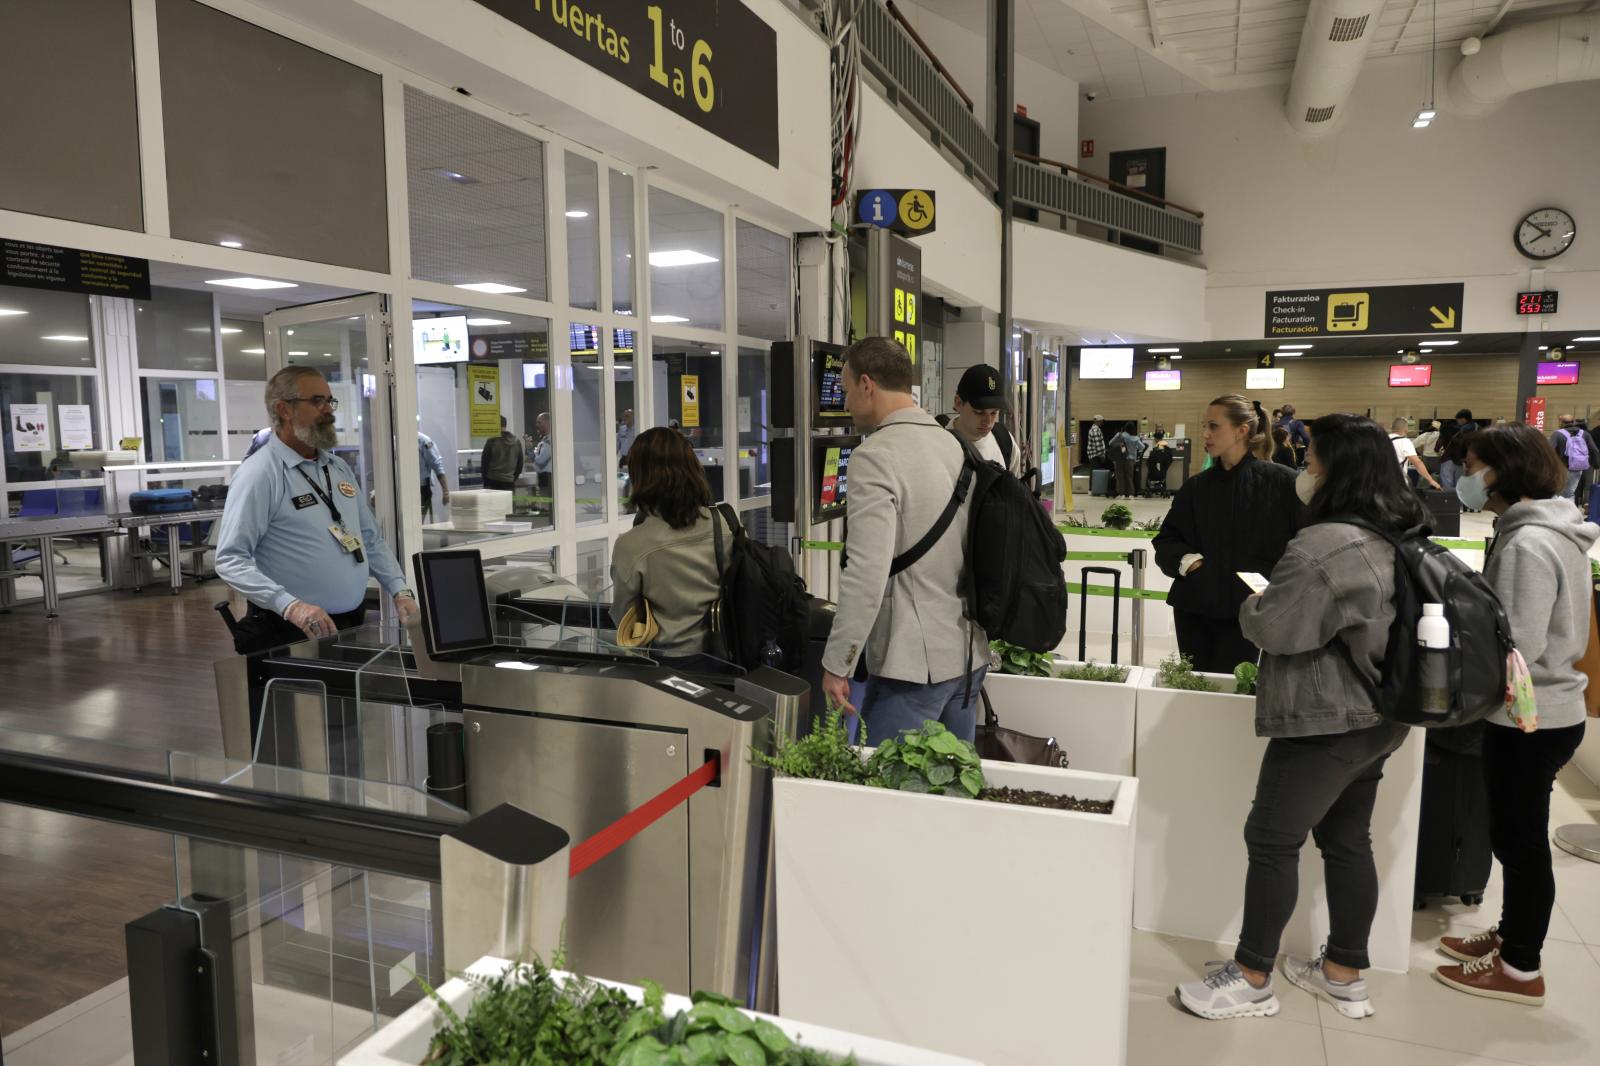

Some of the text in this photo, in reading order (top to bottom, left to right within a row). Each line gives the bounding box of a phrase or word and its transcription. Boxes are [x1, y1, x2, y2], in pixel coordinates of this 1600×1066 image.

[670, 18, 685, 50] to
[534, 0, 714, 112] uertas 1 a 6
[1273, 294, 1320, 303] Fakturazioa
[1272, 305, 1306, 314] Check-in
[1272, 315, 1315, 324] Facturation
[1272, 325, 1319, 334] Facturación
[1407, 351, 1416, 363] 5
[1551, 347, 1562, 360] 6
[1261, 354, 1271, 366] 4
